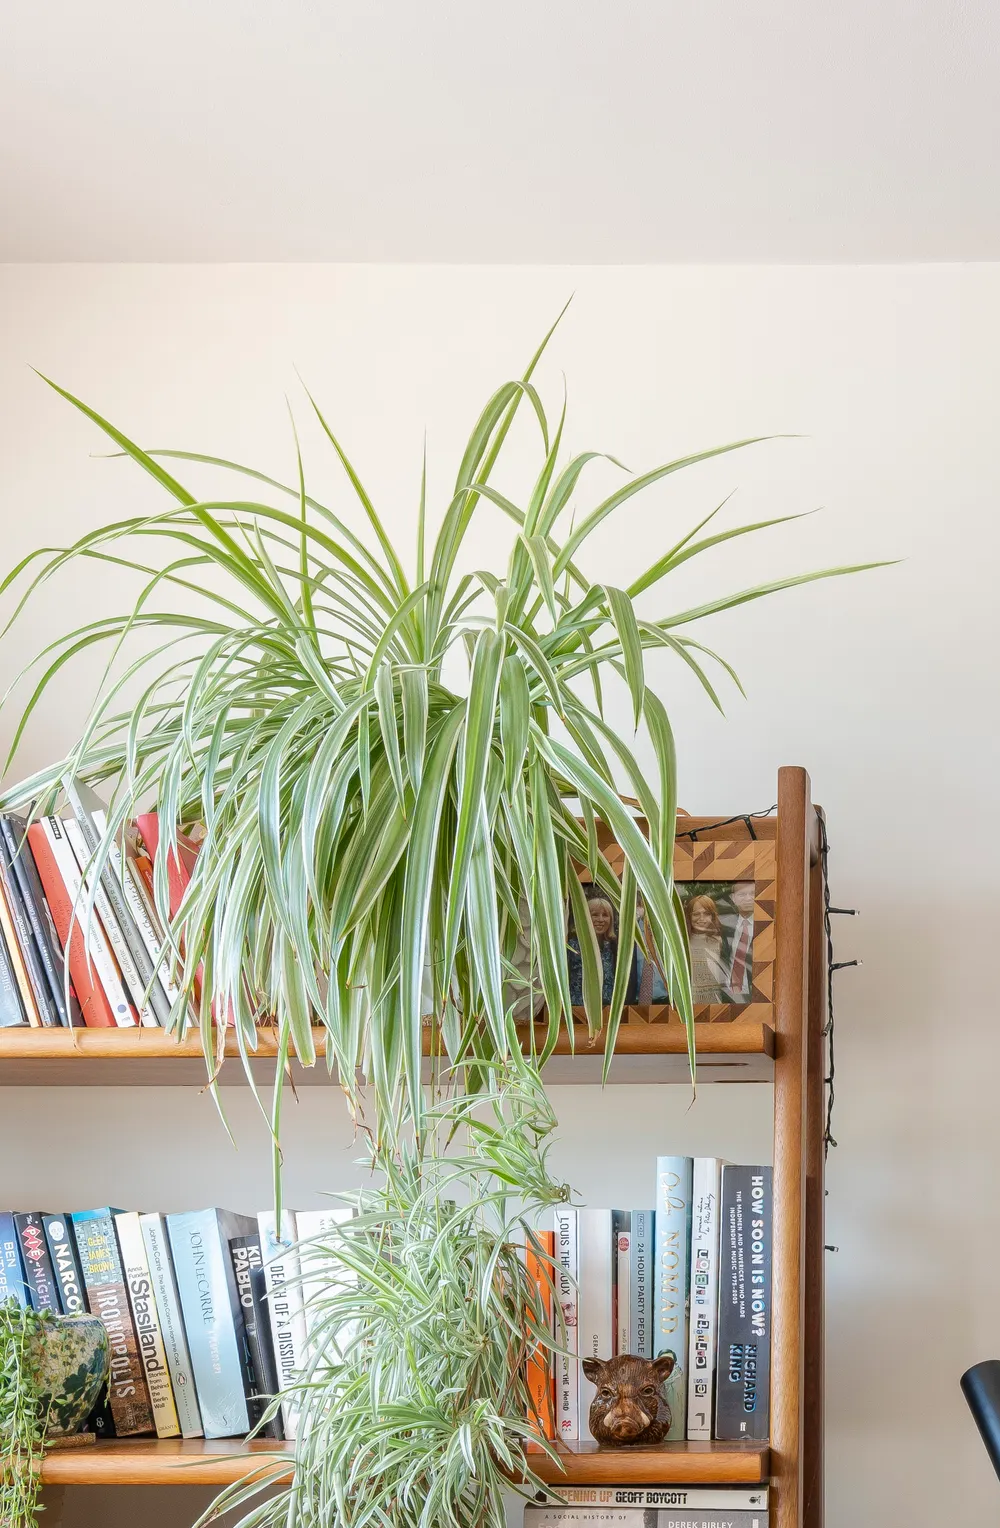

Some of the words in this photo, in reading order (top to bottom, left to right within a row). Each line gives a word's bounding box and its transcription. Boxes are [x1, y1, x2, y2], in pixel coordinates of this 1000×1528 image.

[47, 816, 60, 838] POINTS
[117, 948, 132, 973] Goffette
[133, 948, 147, 974] DAMOTTE
[127, 972, 138, 986] Guy
[752, 1175, 764, 1214] HOW
[4, 1242, 16, 1268] BEN
[188, 1230, 205, 1265] JOHN
[637, 1243, 644, 1253] 24
[752, 1219, 764, 1263] SOON
[89, 1261, 115, 1274] BROWN
[195, 1267, 206, 1278] LE
[231, 1246, 254, 1308] PABLO
[660, 1230, 680, 1334] NOMAD
[752, 1269, 764, 1284] IS
[196, 1279, 216, 1324] CARRÉ
[637, 1286, 645, 1314] PARTY
[752, 1289, 765, 1336] NOW?
[129, 1278, 164, 1373] Stasiland
[637, 1317, 645, 1353] PEOPLE
[95, 1288, 135, 1399] IRONOPOLIS
[729, 1344, 743, 1383] KING
[744, 1344, 757, 1412] RICHARD
[600, 1490, 612, 1503] UP
[615, 1491, 644, 1504] GEOFF
[646, 1492, 688, 1505] BOYCOTT
